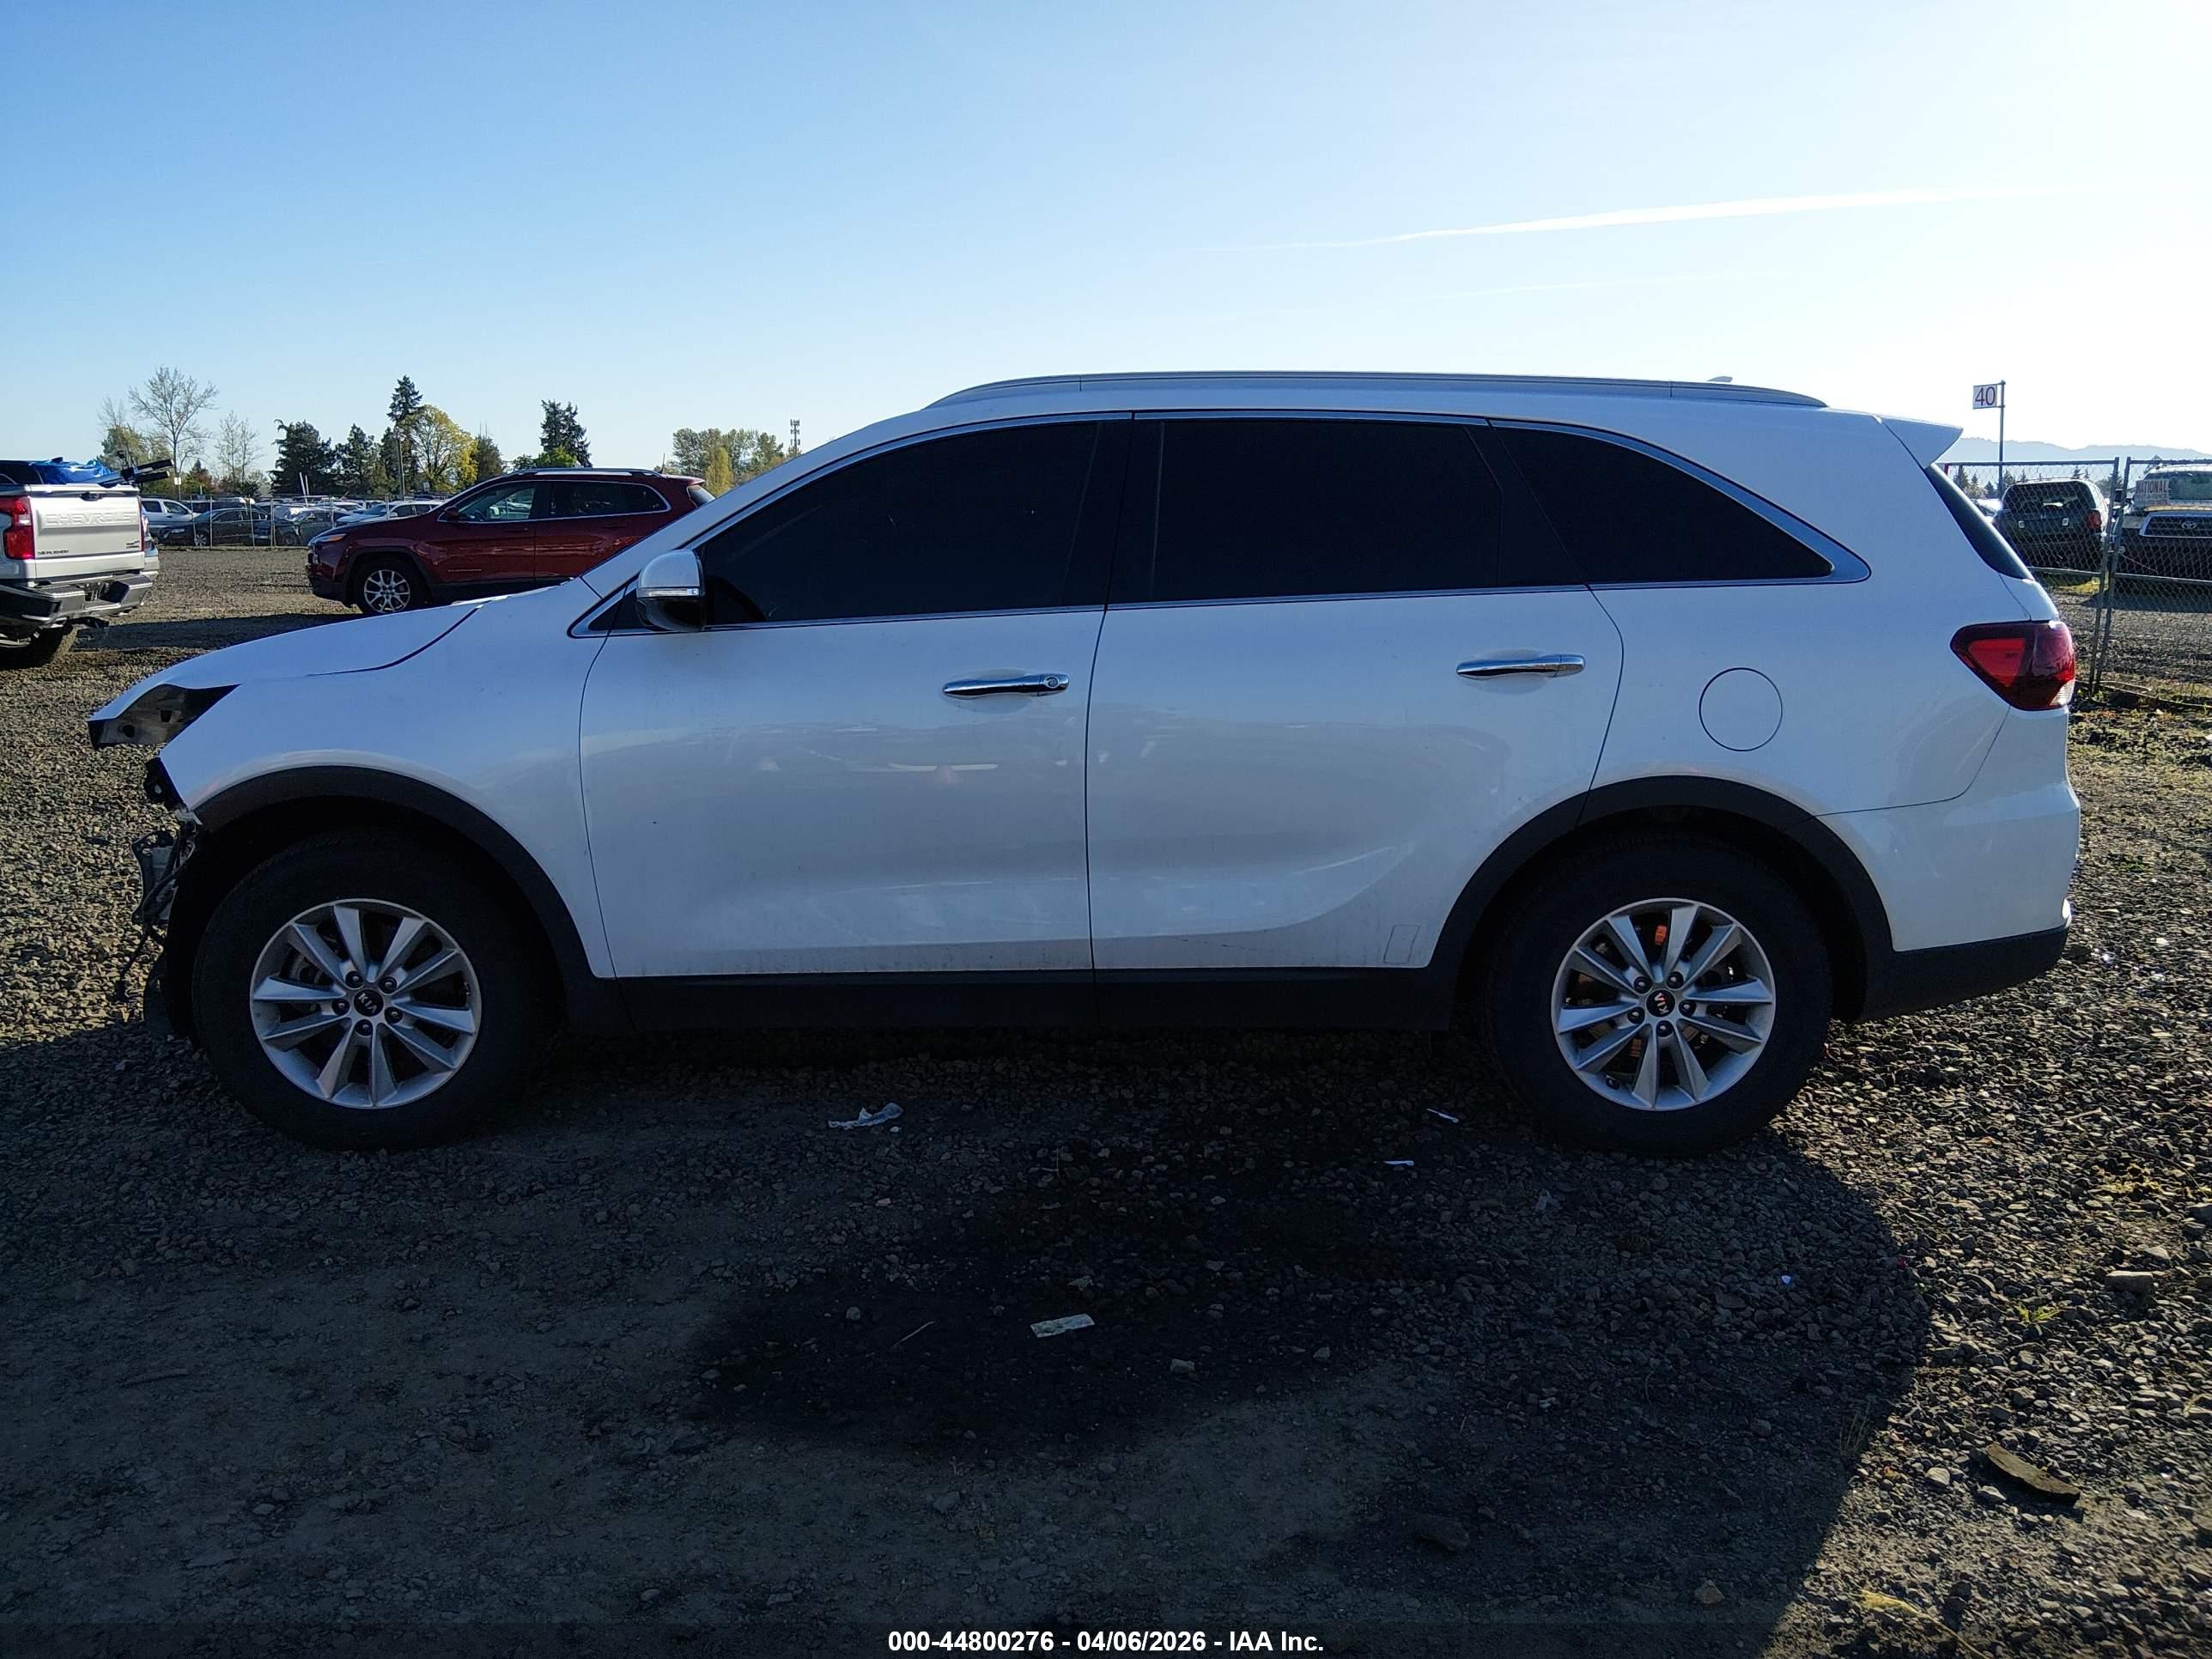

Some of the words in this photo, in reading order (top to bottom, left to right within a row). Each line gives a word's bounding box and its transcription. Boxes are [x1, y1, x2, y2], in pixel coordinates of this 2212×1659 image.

[1975, 386, 1996, 406] 40
[45, 511, 137, 526] CHEVROLET
[358, 993, 378, 1014] KIA
[1654, 992, 1670, 1015] KIA
